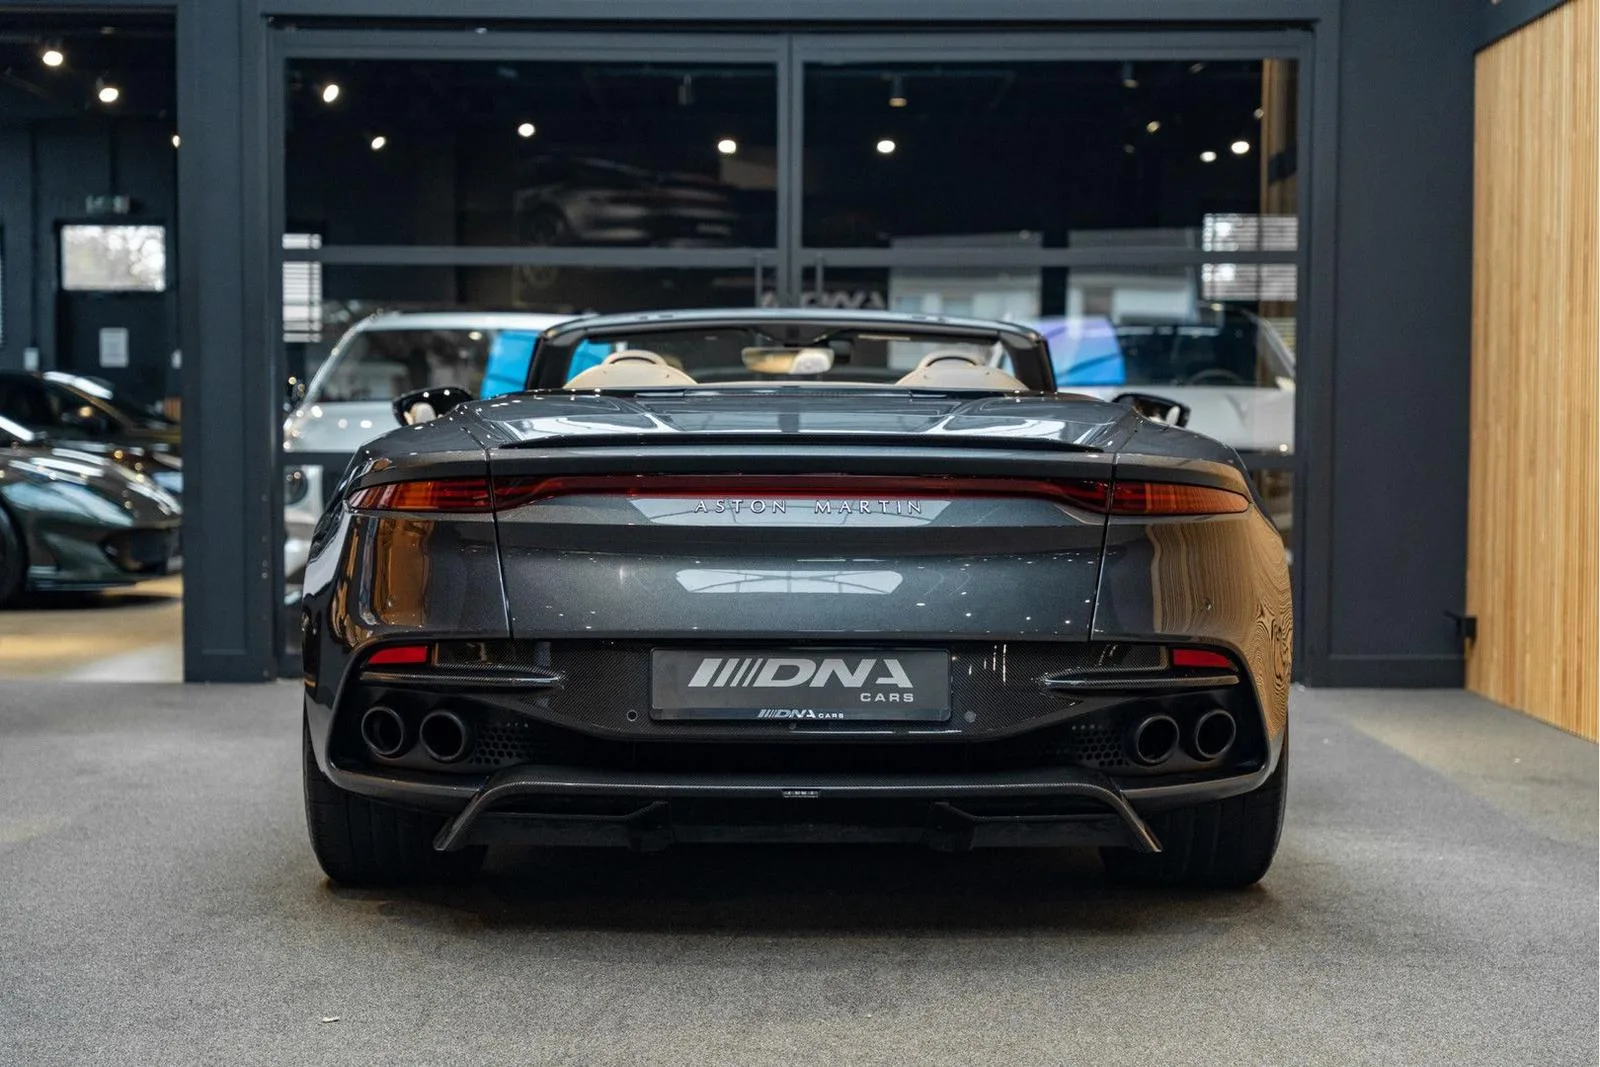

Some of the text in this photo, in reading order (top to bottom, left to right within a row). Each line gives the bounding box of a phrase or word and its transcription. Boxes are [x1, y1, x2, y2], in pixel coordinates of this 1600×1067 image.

[694, 499, 922, 514] ASTON MARTIN
[860, 692, 914, 703] CARS
